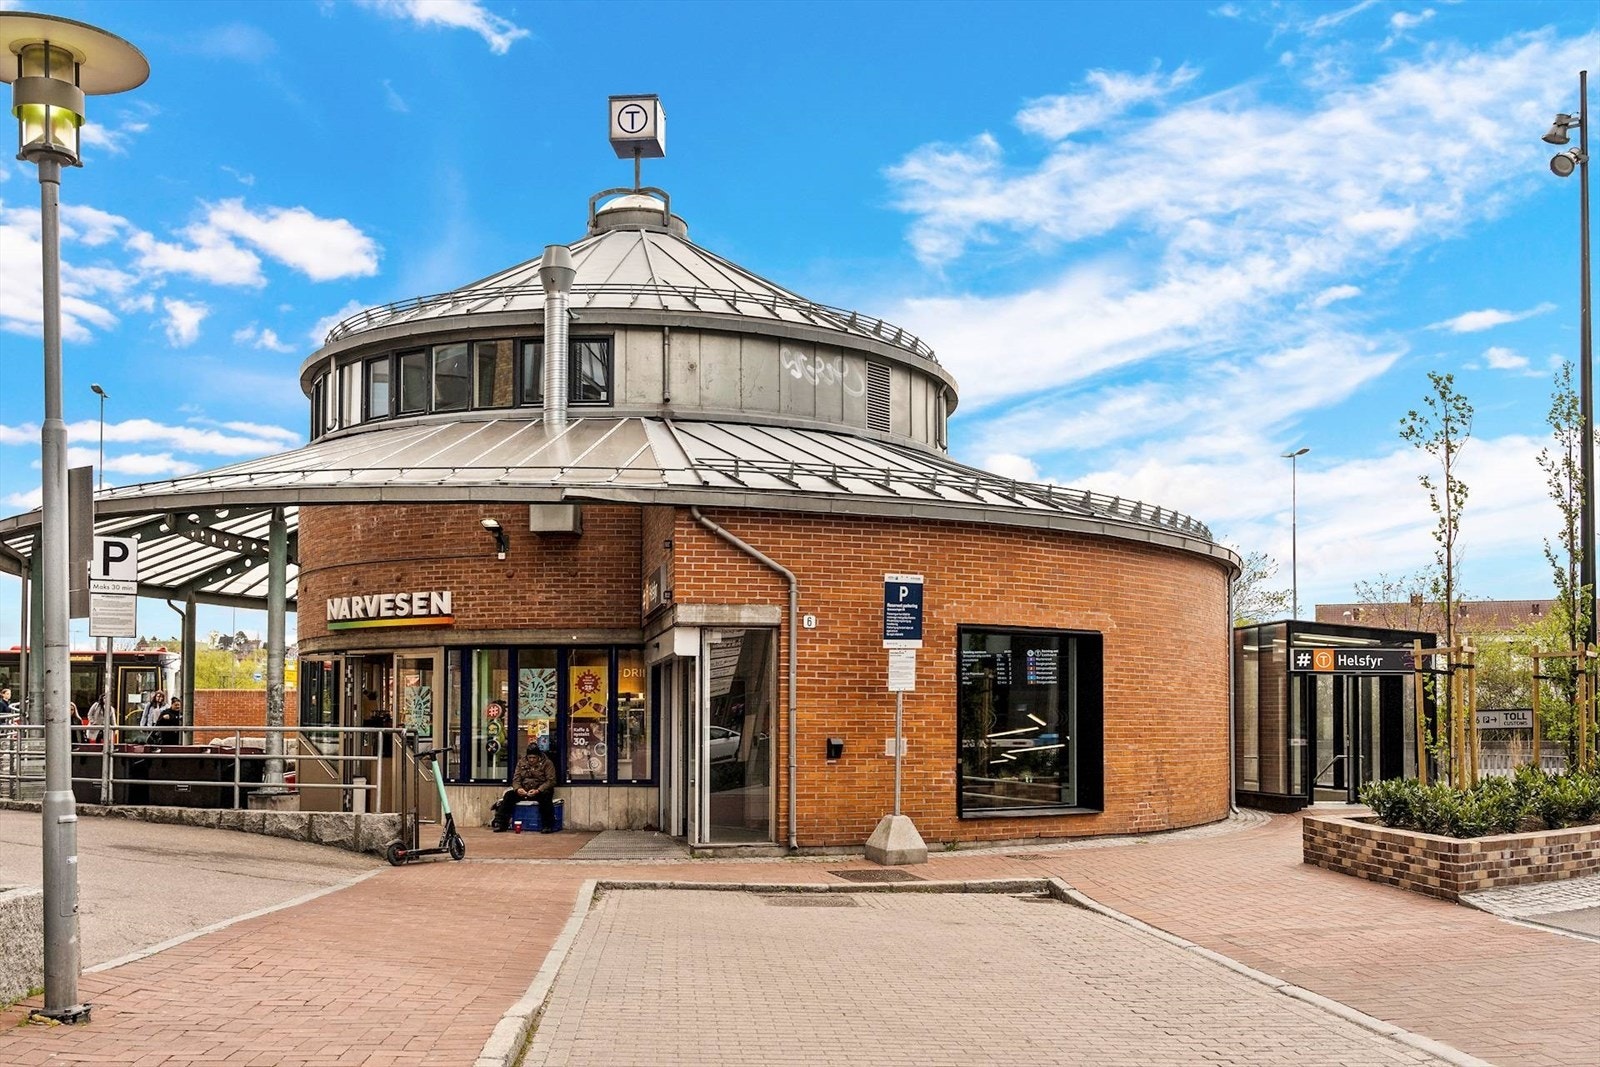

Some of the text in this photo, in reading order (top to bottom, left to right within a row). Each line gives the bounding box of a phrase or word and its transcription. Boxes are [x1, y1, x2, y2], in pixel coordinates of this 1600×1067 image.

[625, 111, 640, 130] T
[103, 541, 129, 576] P
[899, 586, 908, 602] P
[327, 590, 452, 621] NARVESEN
[807, 616, 812, 627] 6
[1338, 654, 1384, 669] Helsfyr
[623, 668, 646, 678] DRI
[531, 681, 544, 693] 1/2
[1503, 712, 1527, 721] TOLL
